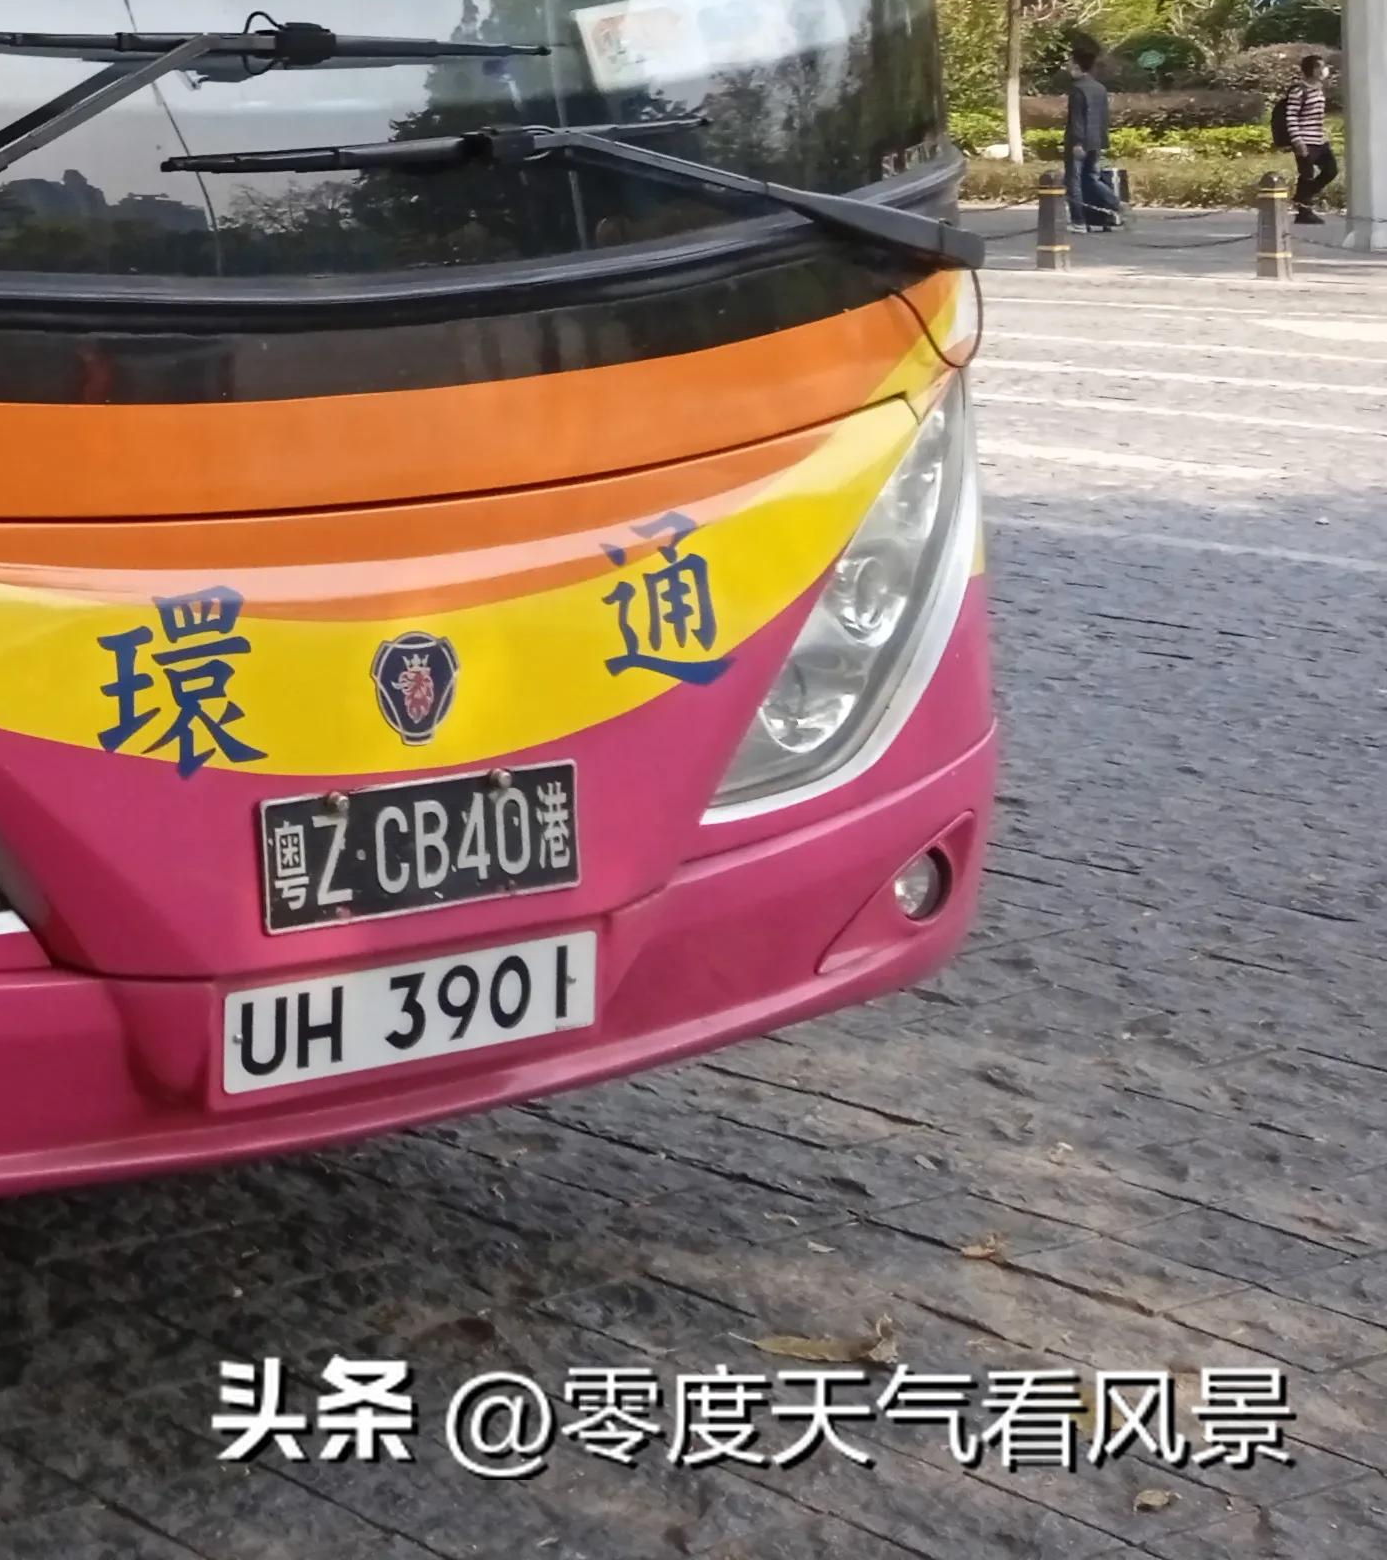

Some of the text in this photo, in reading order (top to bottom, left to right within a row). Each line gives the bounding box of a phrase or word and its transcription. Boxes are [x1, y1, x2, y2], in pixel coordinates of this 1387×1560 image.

[96, 511, 737, 778] 環 通
[240, 944, 568, 1077] UH 3901
